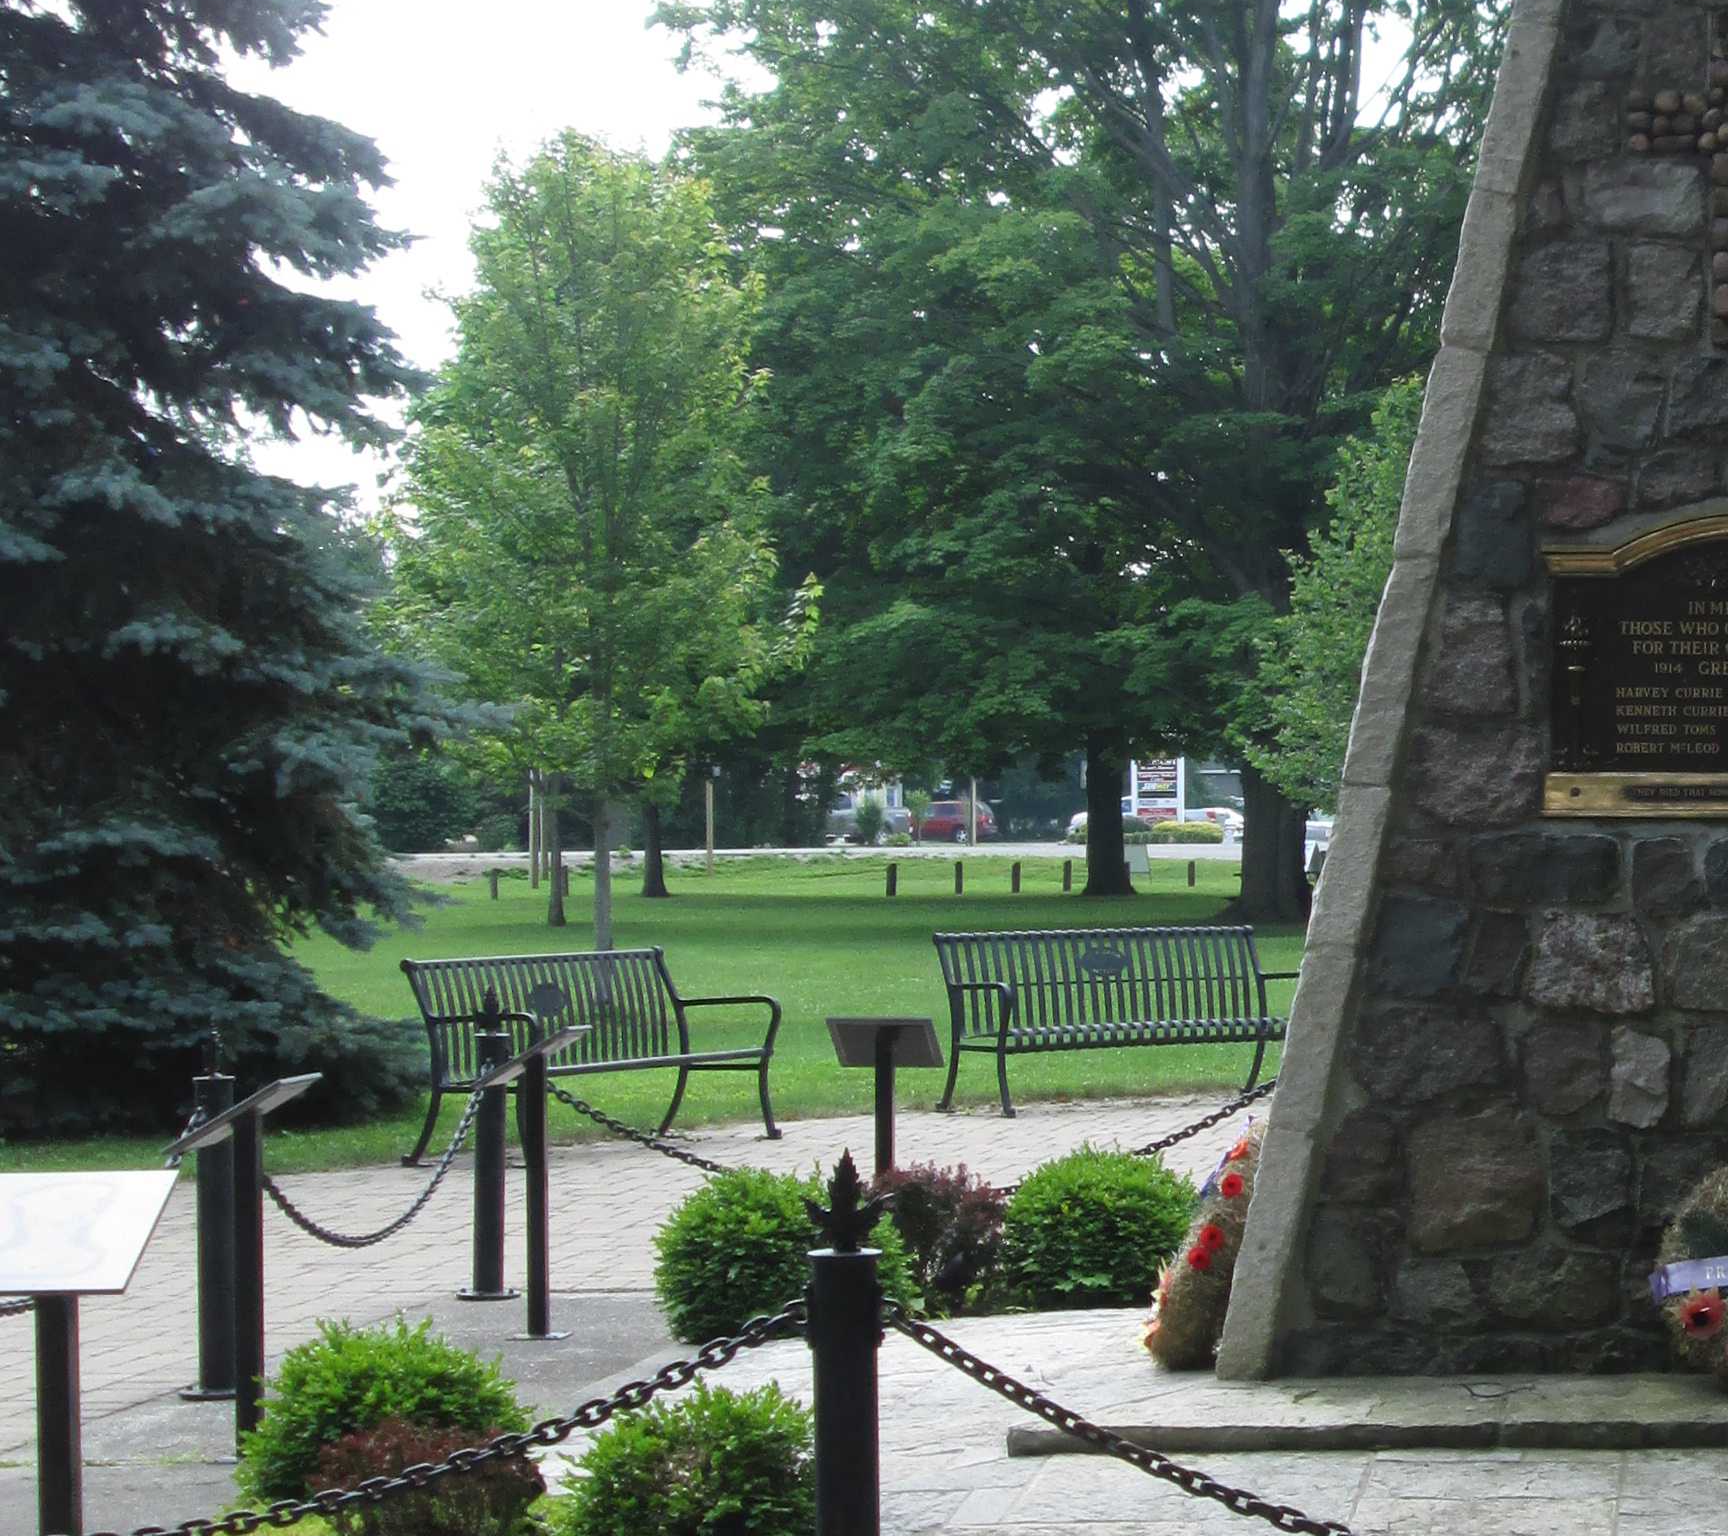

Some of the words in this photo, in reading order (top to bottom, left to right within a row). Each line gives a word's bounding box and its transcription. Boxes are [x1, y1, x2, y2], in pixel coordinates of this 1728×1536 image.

[1688, 600, 1705, 616] IN
[1620, 620, 1673, 636] THOSE
[1679, 620, 1720, 636] WHO
[1632, 640, 1664, 656] FOR
[1668, 640, 1720, 656] THEIR
[1654, 661, 1684, 676] 1914
[1615, 686, 1670, 699] HARVEY
[1674, 686, 1723, 699] CURRIE
[1615, 705, 1677, 717] KENNETH
[1615, 723, 1678, 736] WILFRED
[1682, 723, 1717, 736] TOMS
[1615, 741, 1665, 754] ROBERT
